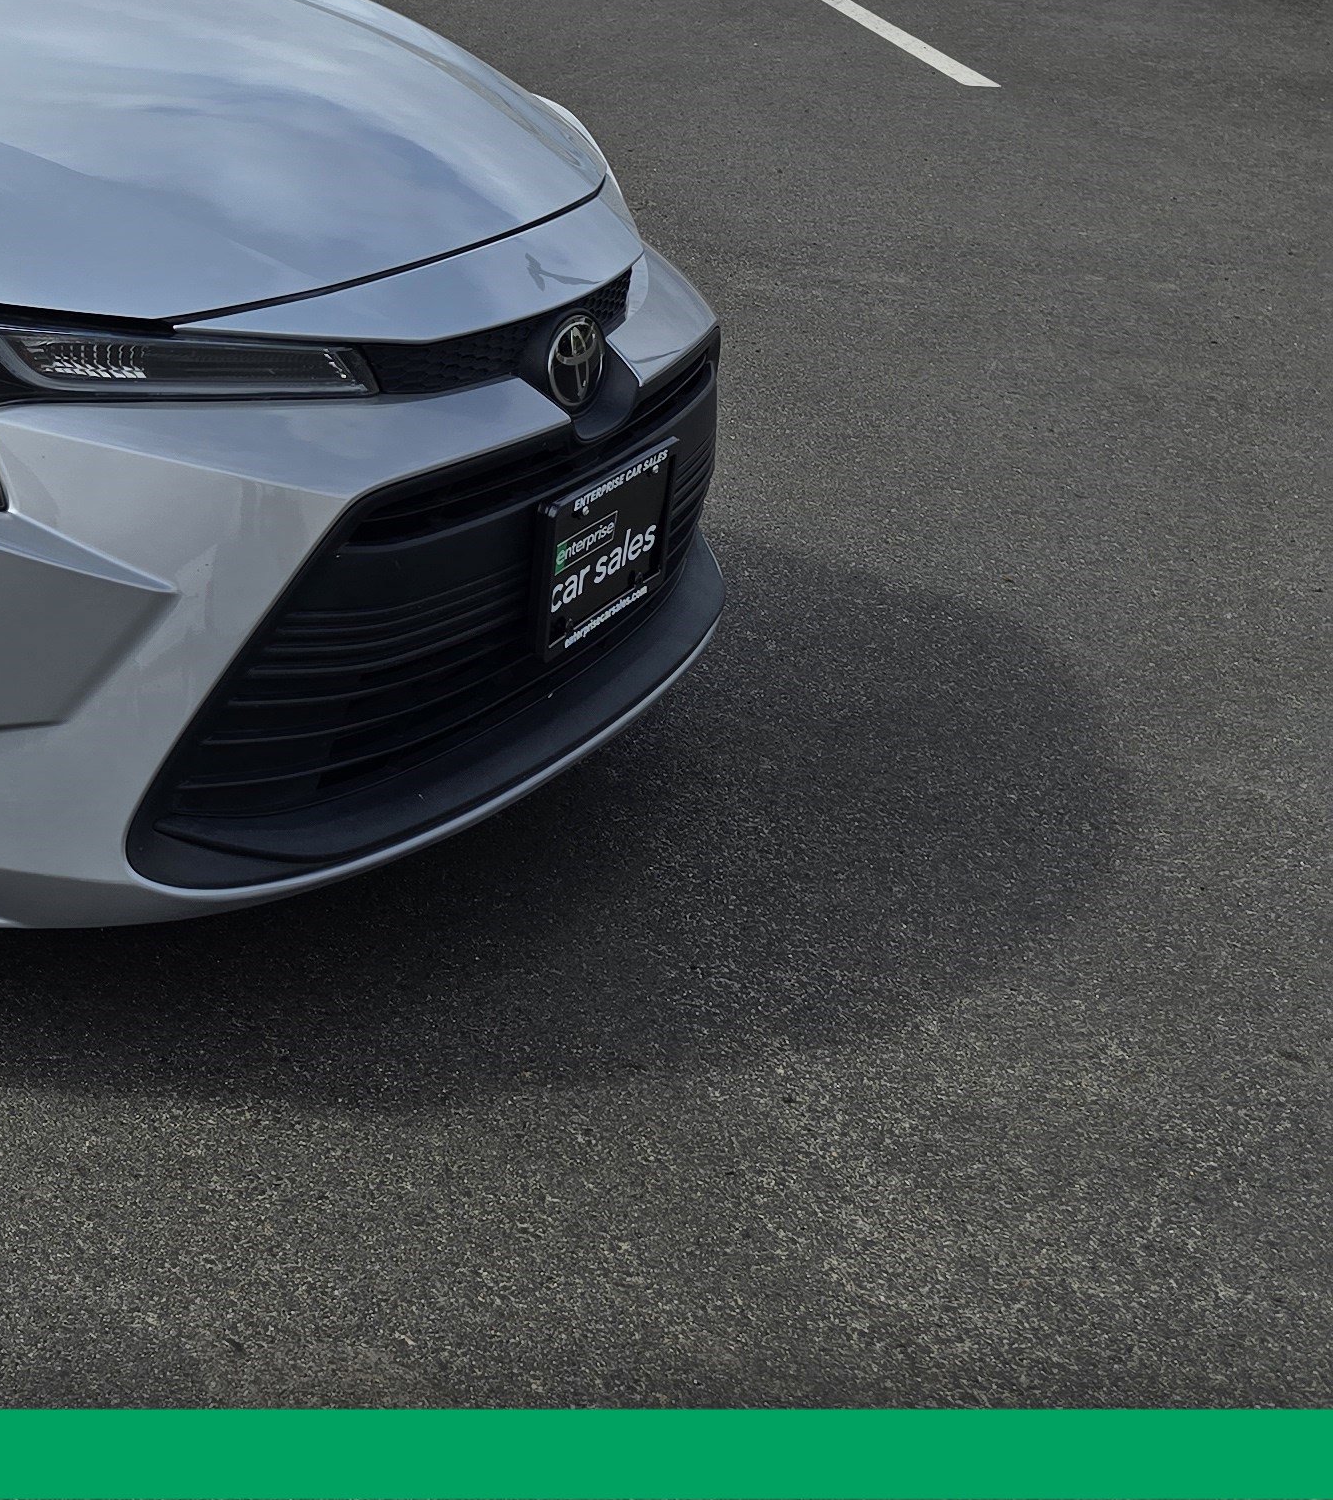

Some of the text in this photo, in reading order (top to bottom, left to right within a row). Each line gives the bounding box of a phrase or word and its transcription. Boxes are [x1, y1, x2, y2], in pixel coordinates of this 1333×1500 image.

[573, 450, 669, 512] ENTERPRISE CAR SALES
[550, 524, 657, 613] car sales
[556, 521, 616, 566] enterprise
[564, 585, 648, 649] enterprisecarsales.com
